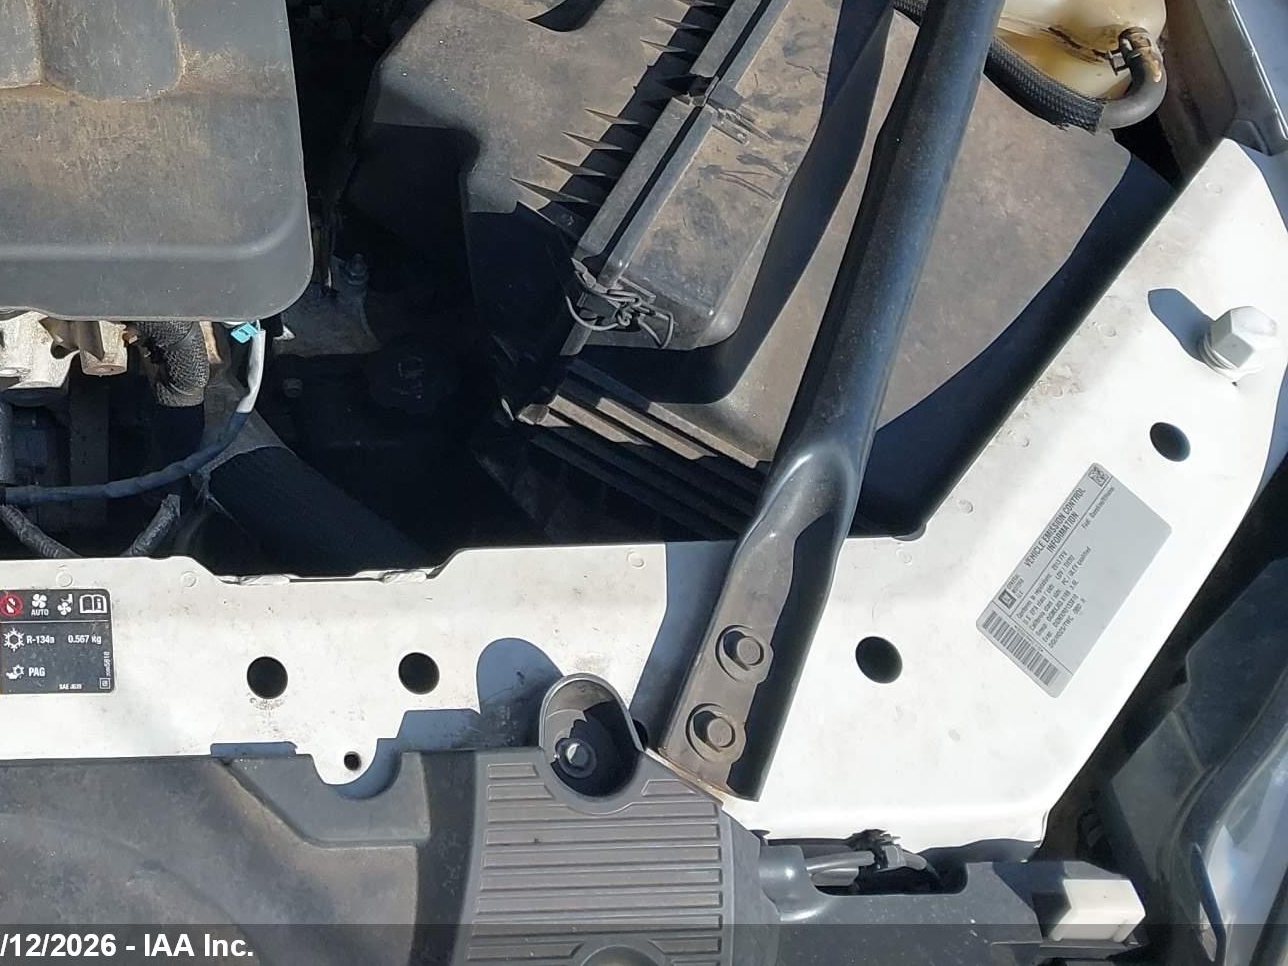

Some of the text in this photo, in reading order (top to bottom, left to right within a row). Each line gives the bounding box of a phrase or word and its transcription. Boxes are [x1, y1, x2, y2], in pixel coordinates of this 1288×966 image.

[1024, 485, 1085, 567] VEHICLE EMISSION CONTROL
[1046, 510, 1079, 553] INFORMATION
[31, 608, 49, 616] AUTO
[26, 635, 55, 644] R-134a
[68, 635, 90, 644] 0.567
[28, 667, 46, 677] PAG
